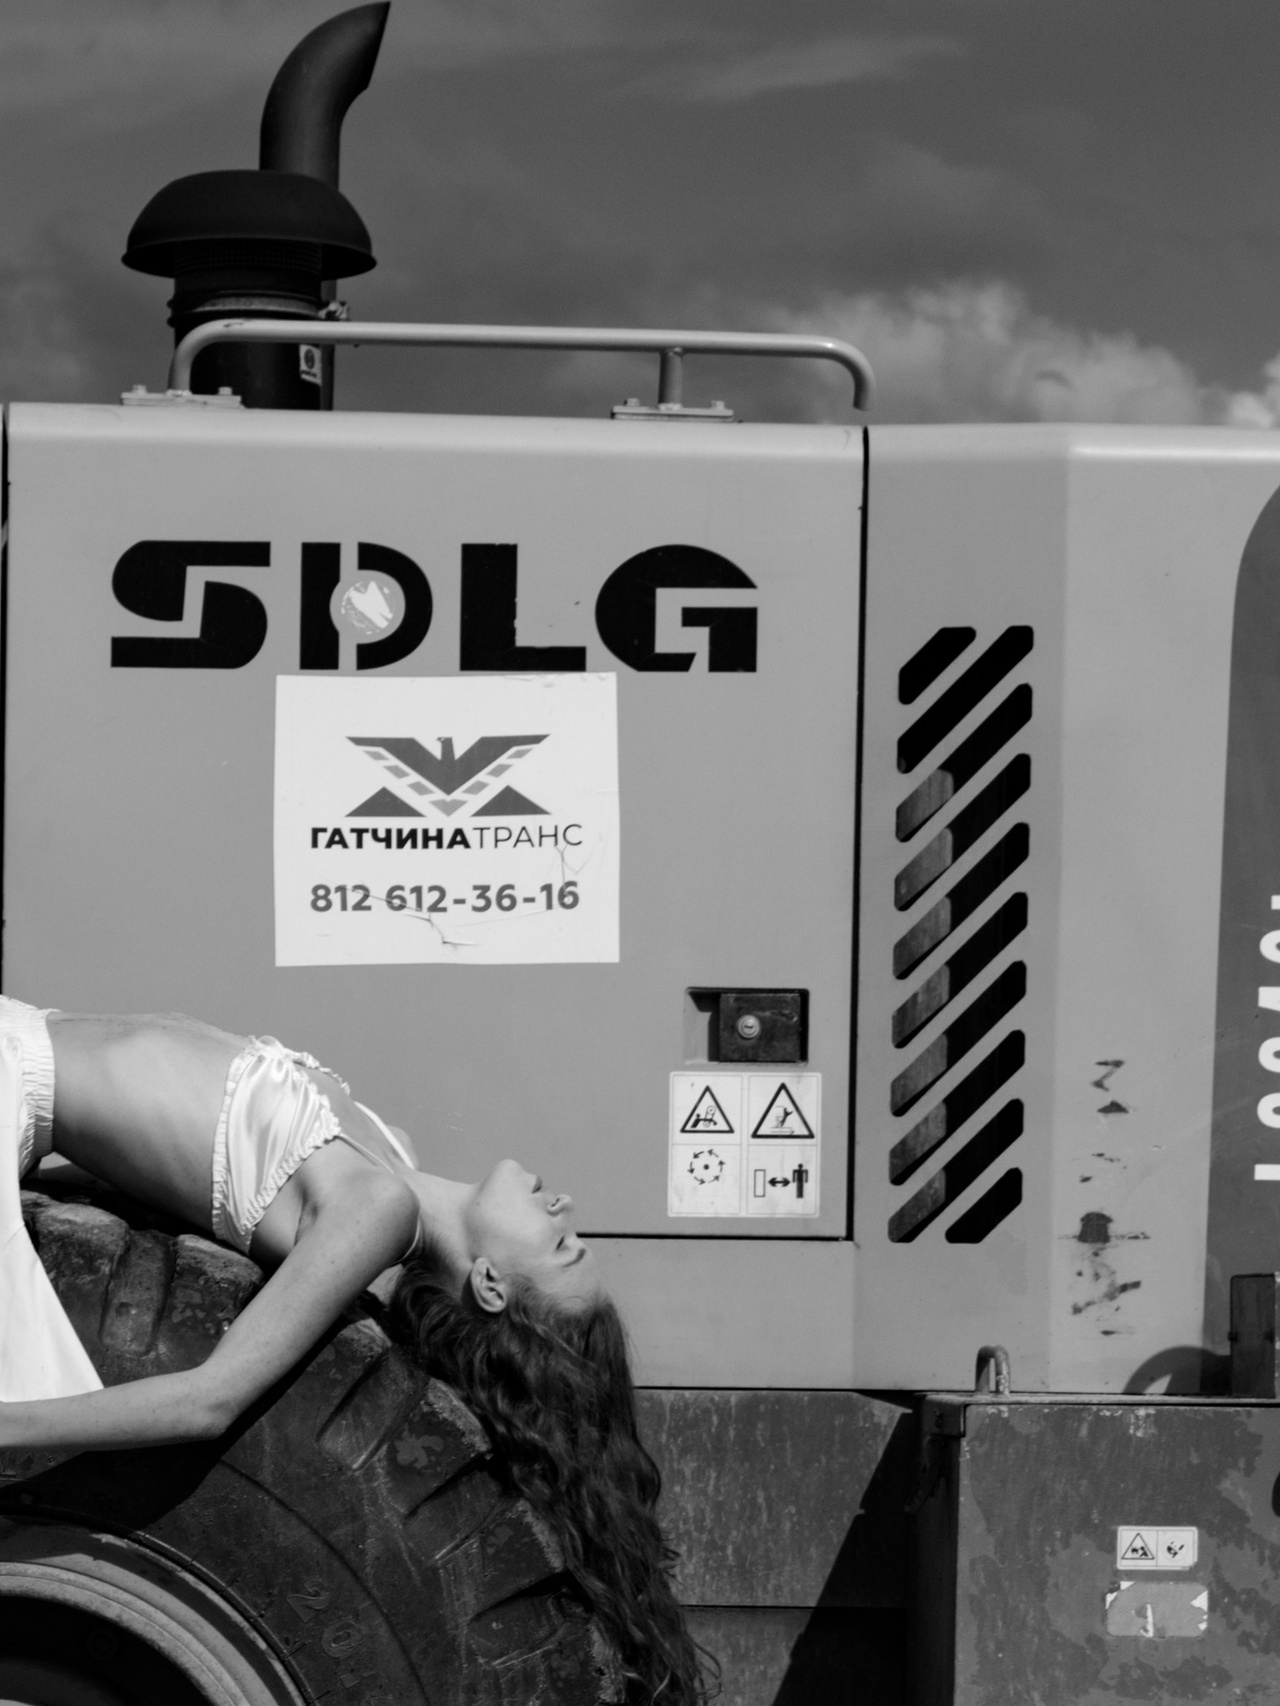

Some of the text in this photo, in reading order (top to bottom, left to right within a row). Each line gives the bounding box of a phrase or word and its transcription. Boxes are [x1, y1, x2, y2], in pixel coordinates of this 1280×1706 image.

[110, 540, 758, 673] SDLG
[310, 824, 583, 849] ГАТЧИНАТРАНС
[310, 880, 580, 913] 812 612-36-16
